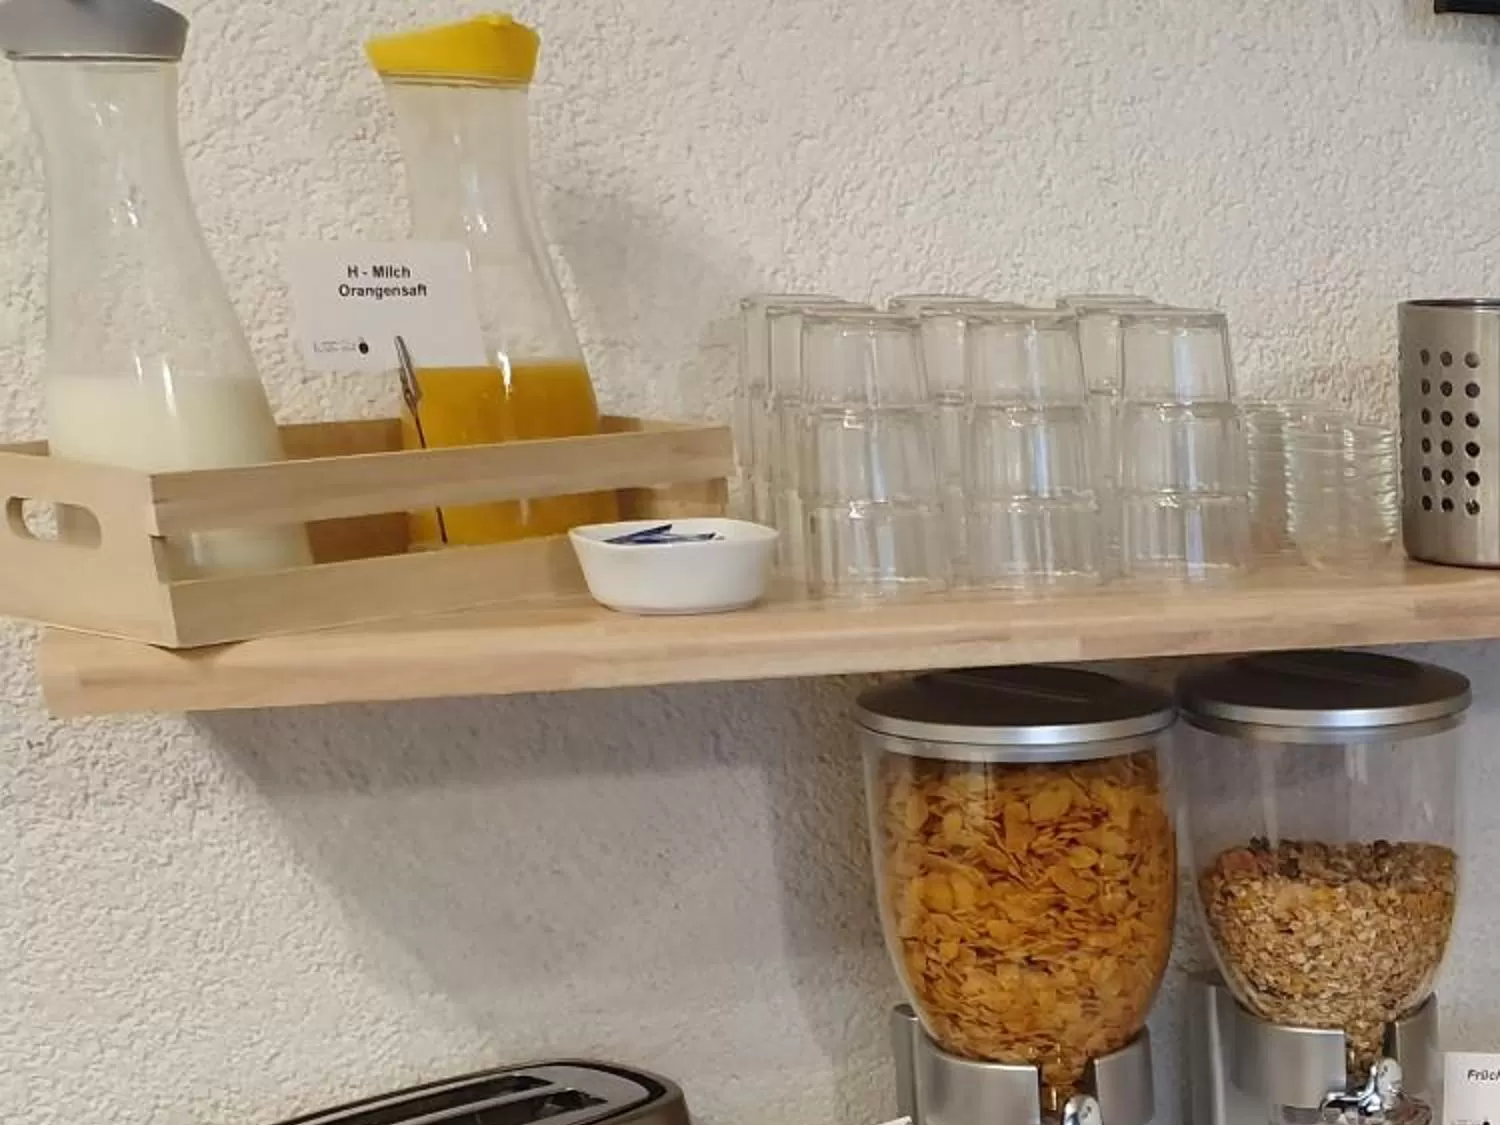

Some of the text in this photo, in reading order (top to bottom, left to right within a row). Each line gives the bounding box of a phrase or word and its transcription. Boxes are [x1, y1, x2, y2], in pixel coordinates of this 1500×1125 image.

[347, 265, 359, 279] H
[372, 265, 411, 279] Milch
[338, 283, 428, 300] Orangensaft
